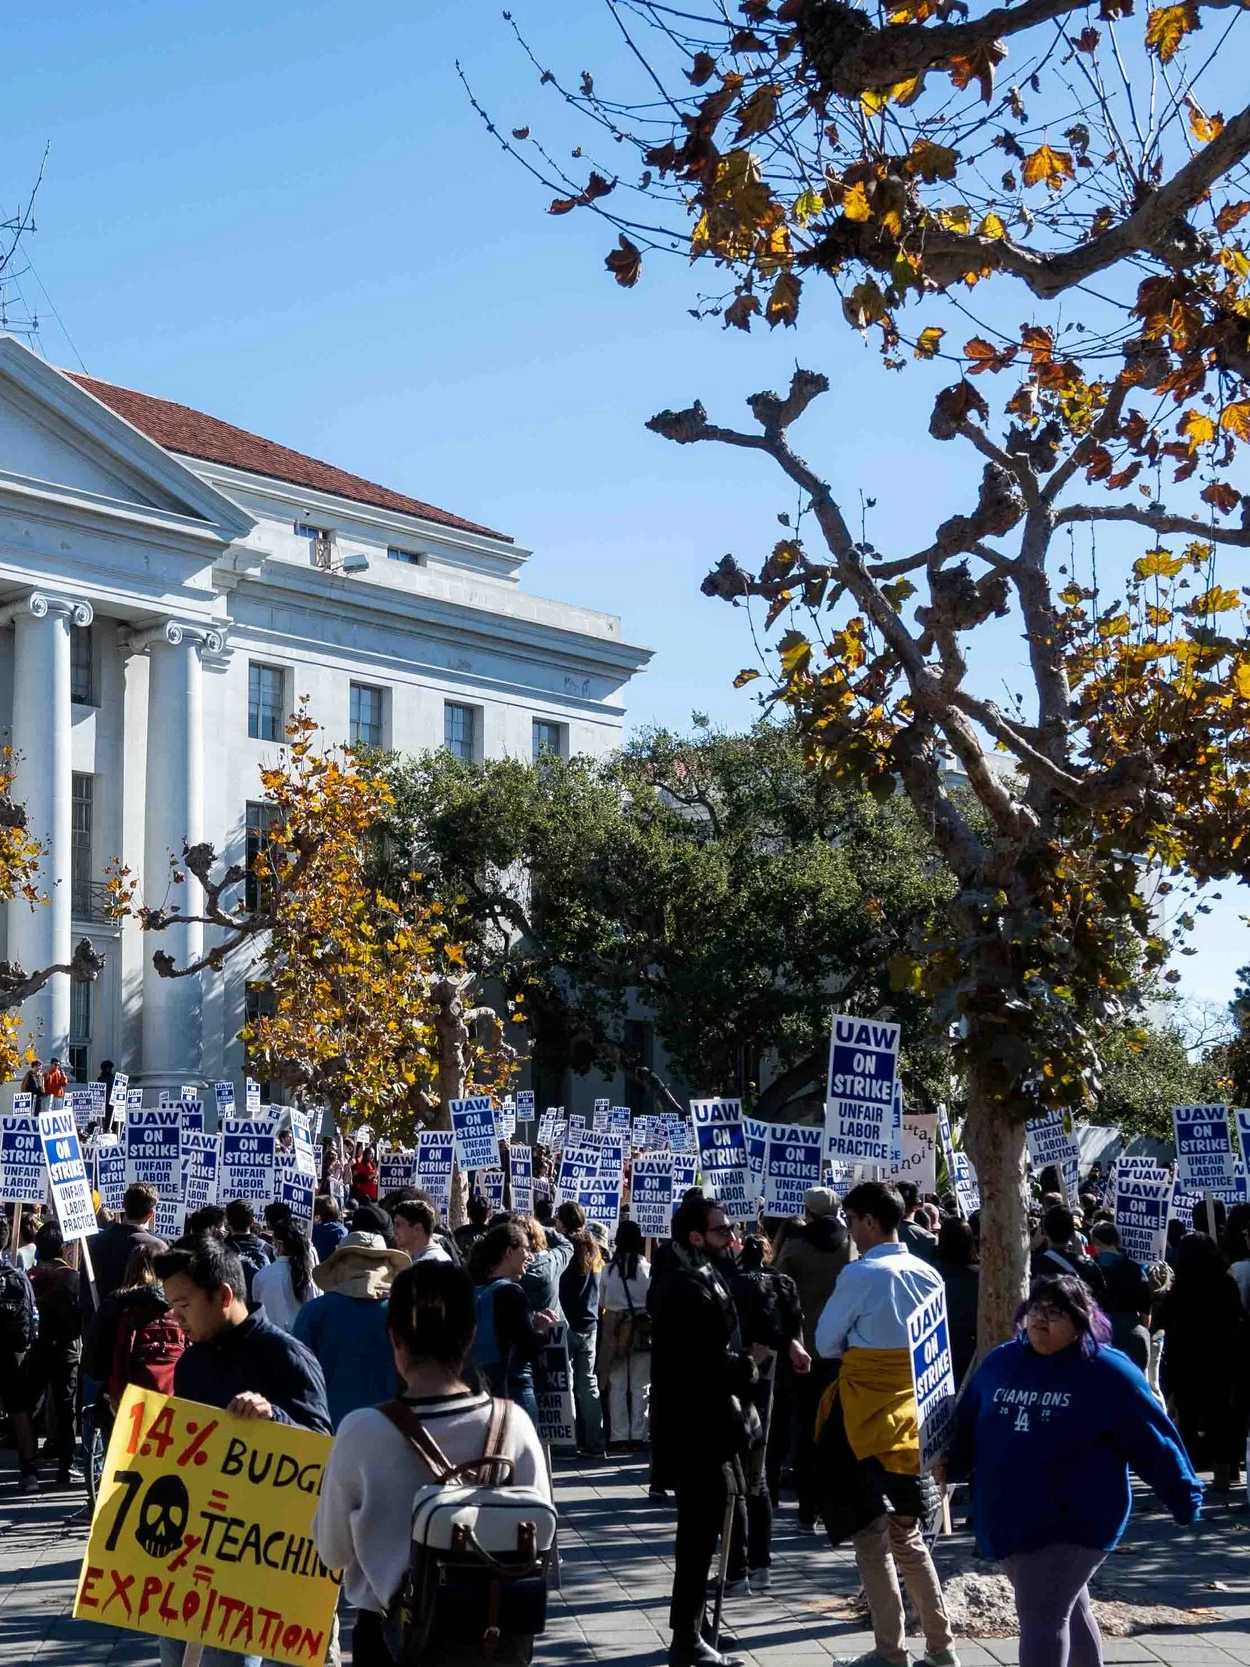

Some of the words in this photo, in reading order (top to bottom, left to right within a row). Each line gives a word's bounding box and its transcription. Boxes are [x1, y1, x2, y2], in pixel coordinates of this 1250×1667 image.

[836, 1021, 898, 1049] UAW
[852, 1053, 876, 1074] ON
[834, 1074, 892, 1100] STRIKE
[452, 1098, 490, 1113] UAW
[694, 1103, 740, 1122] UAW
[838, 1102, 883, 1122] UNFAIR
[1176, 1108, 1224, 1122] UAW
[129, 1112, 179, 1126] UAW
[466, 1114, 482, 1125] ON
[41, 1115, 72, 1136] UAW
[226, 1122, 274, 1135] UAW
[456, 1124, 494, 1138] STRIKE
[840, 1120, 880, 1140] LABOR
[1193, 1126, 1212, 1136] ON
[144, 1130, 163, 1142] ON
[421, 1134, 454, 1145] UAW
[712, 1128, 731, 1146] ON
[771, 1127, 822, 1145] UAW
[15, 1136, 34, 1149] ON
[239, 1139, 258, 1151] ON
[462, 1139, 492, 1149] UNFAIR
[829, 1137, 888, 1158] PRACTICE
[1037, 1137, 1068, 1151] LABOR
[1180, 1140, 1228, 1152] STRIKE
[56, 1140, 71, 1159] ON
[130, 1144, 178, 1157] STRIKE
[430, 1149, 442, 1160] ON
[466, 1148, 492, 1158] LABOR
[510, 1148, 530, 1159] UAW
[603, 1148, 614, 1158] ON
[785, 1147, 805, 1161] ON
[1033, 1146, 1078, 1165] PRACTICE
[1, 1150, 46, 1164] STRIKE
[190, 1152, 204, 1162] ON
[224, 1152, 272, 1166] STRIKE
[381, 1156, 414, 1165] UAW
[460, 1156, 499, 1168] PRACTICE
[565, 1150, 600, 1166] UAW
[702, 1148, 746, 1167] STRIKE
[1119, 1158, 1154, 1168] UAW
[1188, 1156, 1224, 1166] UNFAIR
[110, 1158, 124, 1170] ON
[134, 1161, 172, 1171] UNFAIR
[419, 1162, 450, 1172] STRIKE
[516, 1164, 525, 1174] ON
[634, 1162, 672, 1174] UAW
[770, 1161, 818, 1177] STRIKE
[4, 1166, 40, 1177] UNFAIR
[51, 1161, 84, 1182] STRIKE
[136, 1172, 170, 1182] LABOR
[230, 1168, 266, 1178] UNFAIR
[391, 1168, 404, 1176] ON
[572, 1166, 586, 1178] ON
[1134, 1170, 1166, 1180] UAW
[1190, 1166, 1224, 1176] LABOR
[5, 1177, 38, 1188] LABOR
[231, 1178, 264, 1188] LABOR
[284, 1170, 314, 1188] UAW
[422, 1176, 446, 1184] UNFAIR
[512, 1176, 530, 1186] STRIKE
[580, 1180, 620, 1190] UAW
[644, 1178, 660, 1189] ON
[710, 1172, 745, 1186] UNFAIR
[776, 1178, 812, 1190] UNFAIR
[1184, 1176, 1232, 1188] PRACTICE
[60, 1184, 85, 1200] UNFAIR
[534, 1181, 548, 1192] UAW
[1118, 1182, 1160, 1198] UAW
[223, 1189, 270, 1200] PRACTICE
[292, 1189, 304, 1202] ON
[590, 1194, 606, 1205] ON
[634, 1190, 670, 1202] STRIKE
[714, 1187, 745, 1201] LABOR
[64, 1200, 88, 1216] LABOR
[636, 1205, 666, 1214] UNFAIR
[1130, 1200, 1146, 1213] ON
[63, 1214, 96, 1233] PRACTICE
[638, 1215, 663, 1224] LABOR
[1118, 1212, 1159, 1228] STRIKE
[1122, 1228, 1153, 1240] UNFAIR
[1122, 1238, 1150, 1250] LABOR
[910, 1294, 943, 1344] UAW
[924, 1333, 938, 1364] ON
[917, 1350, 950, 1400] STRIKE
[923, 1384, 948, 1418] UNFAIR
[1014, 1406, 1029, 1432] LA
[221, 1437, 325, 1496] BUDG
[79, 1566, 324, 1658] EXPLOITATION
